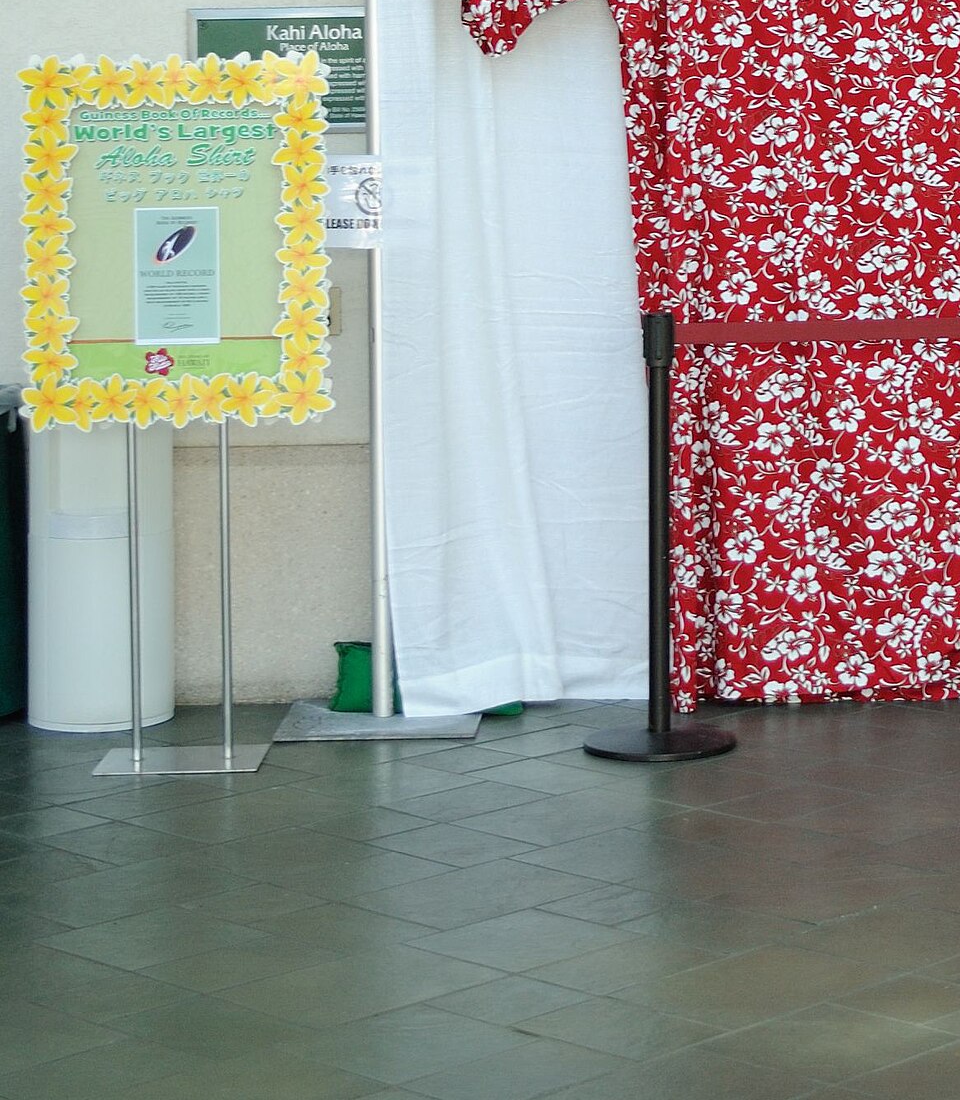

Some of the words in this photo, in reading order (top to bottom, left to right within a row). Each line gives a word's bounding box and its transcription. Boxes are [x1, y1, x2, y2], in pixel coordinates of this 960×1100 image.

[266, 25, 306, 41] Kahi
[308, 23, 363, 40] Aloha
[280, 42, 306, 51] Place
[307, 42, 319, 51] of
[319, 41, 350, 51] Aloha
[79, 110, 137, 121] Guiness
[141, 109, 176, 120] Book
[180, 109, 199, 120] Of
[74, 124, 172, 142] World's
[177, 123, 277, 145] Largest
[96, 144, 177, 168] Aloha
[186, 143, 256, 167] Shirt
[326, 218, 354, 229] LEASE
[139, 269, 174, 278] WORLD
[176, 268, 216, 277] RECORD
